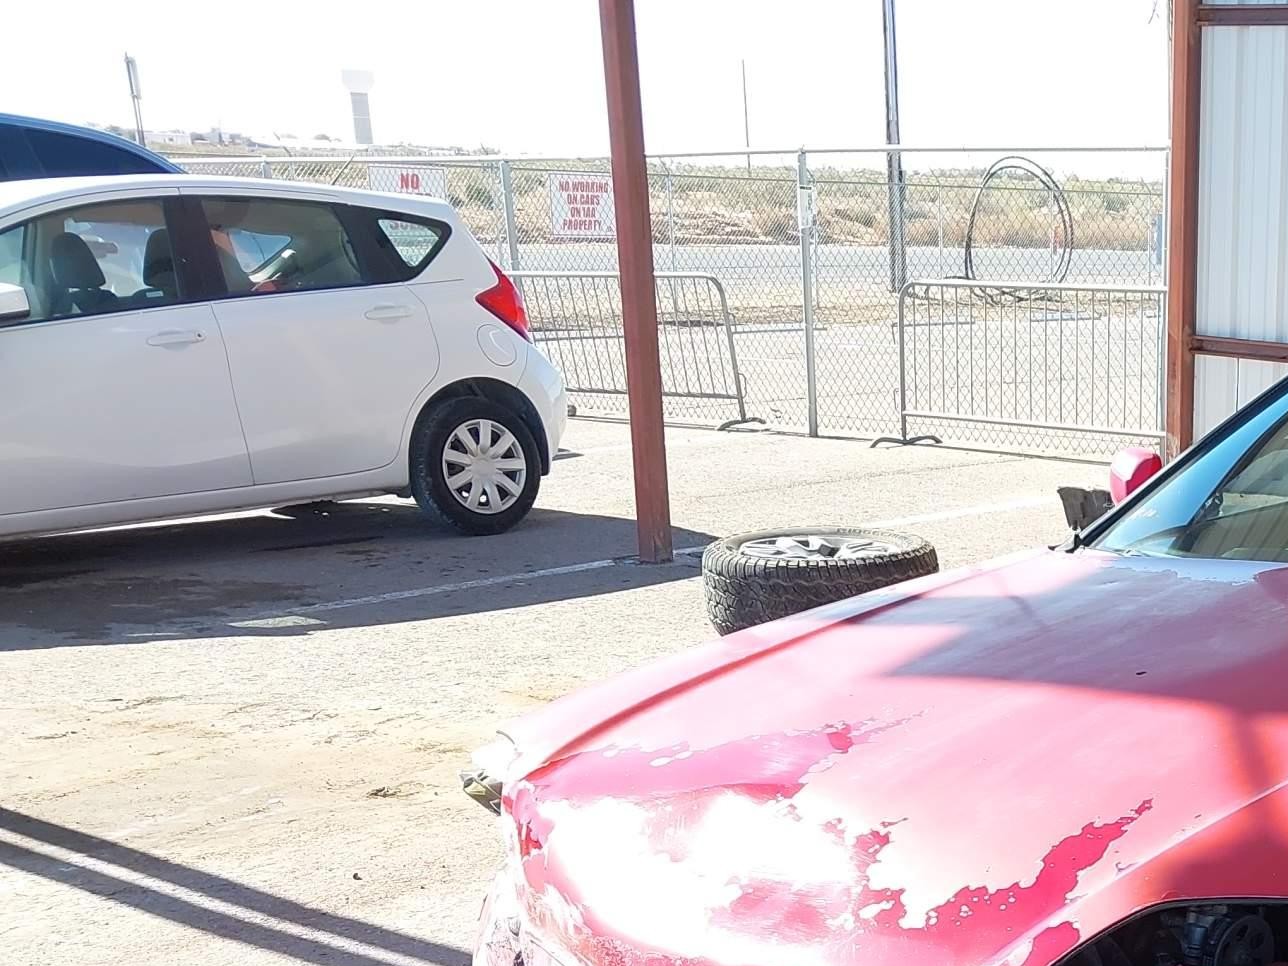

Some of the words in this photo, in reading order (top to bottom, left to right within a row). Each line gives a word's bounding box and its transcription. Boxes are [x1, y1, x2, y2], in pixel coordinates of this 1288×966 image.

[401, 173, 420, 190] NO
[559, 181, 570, 193] NO
[572, 181, 609, 193] WORKING
[567, 194, 577, 205] ON
[571, 207, 581, 218] ON
[563, 219, 602, 231] PROPERTY
